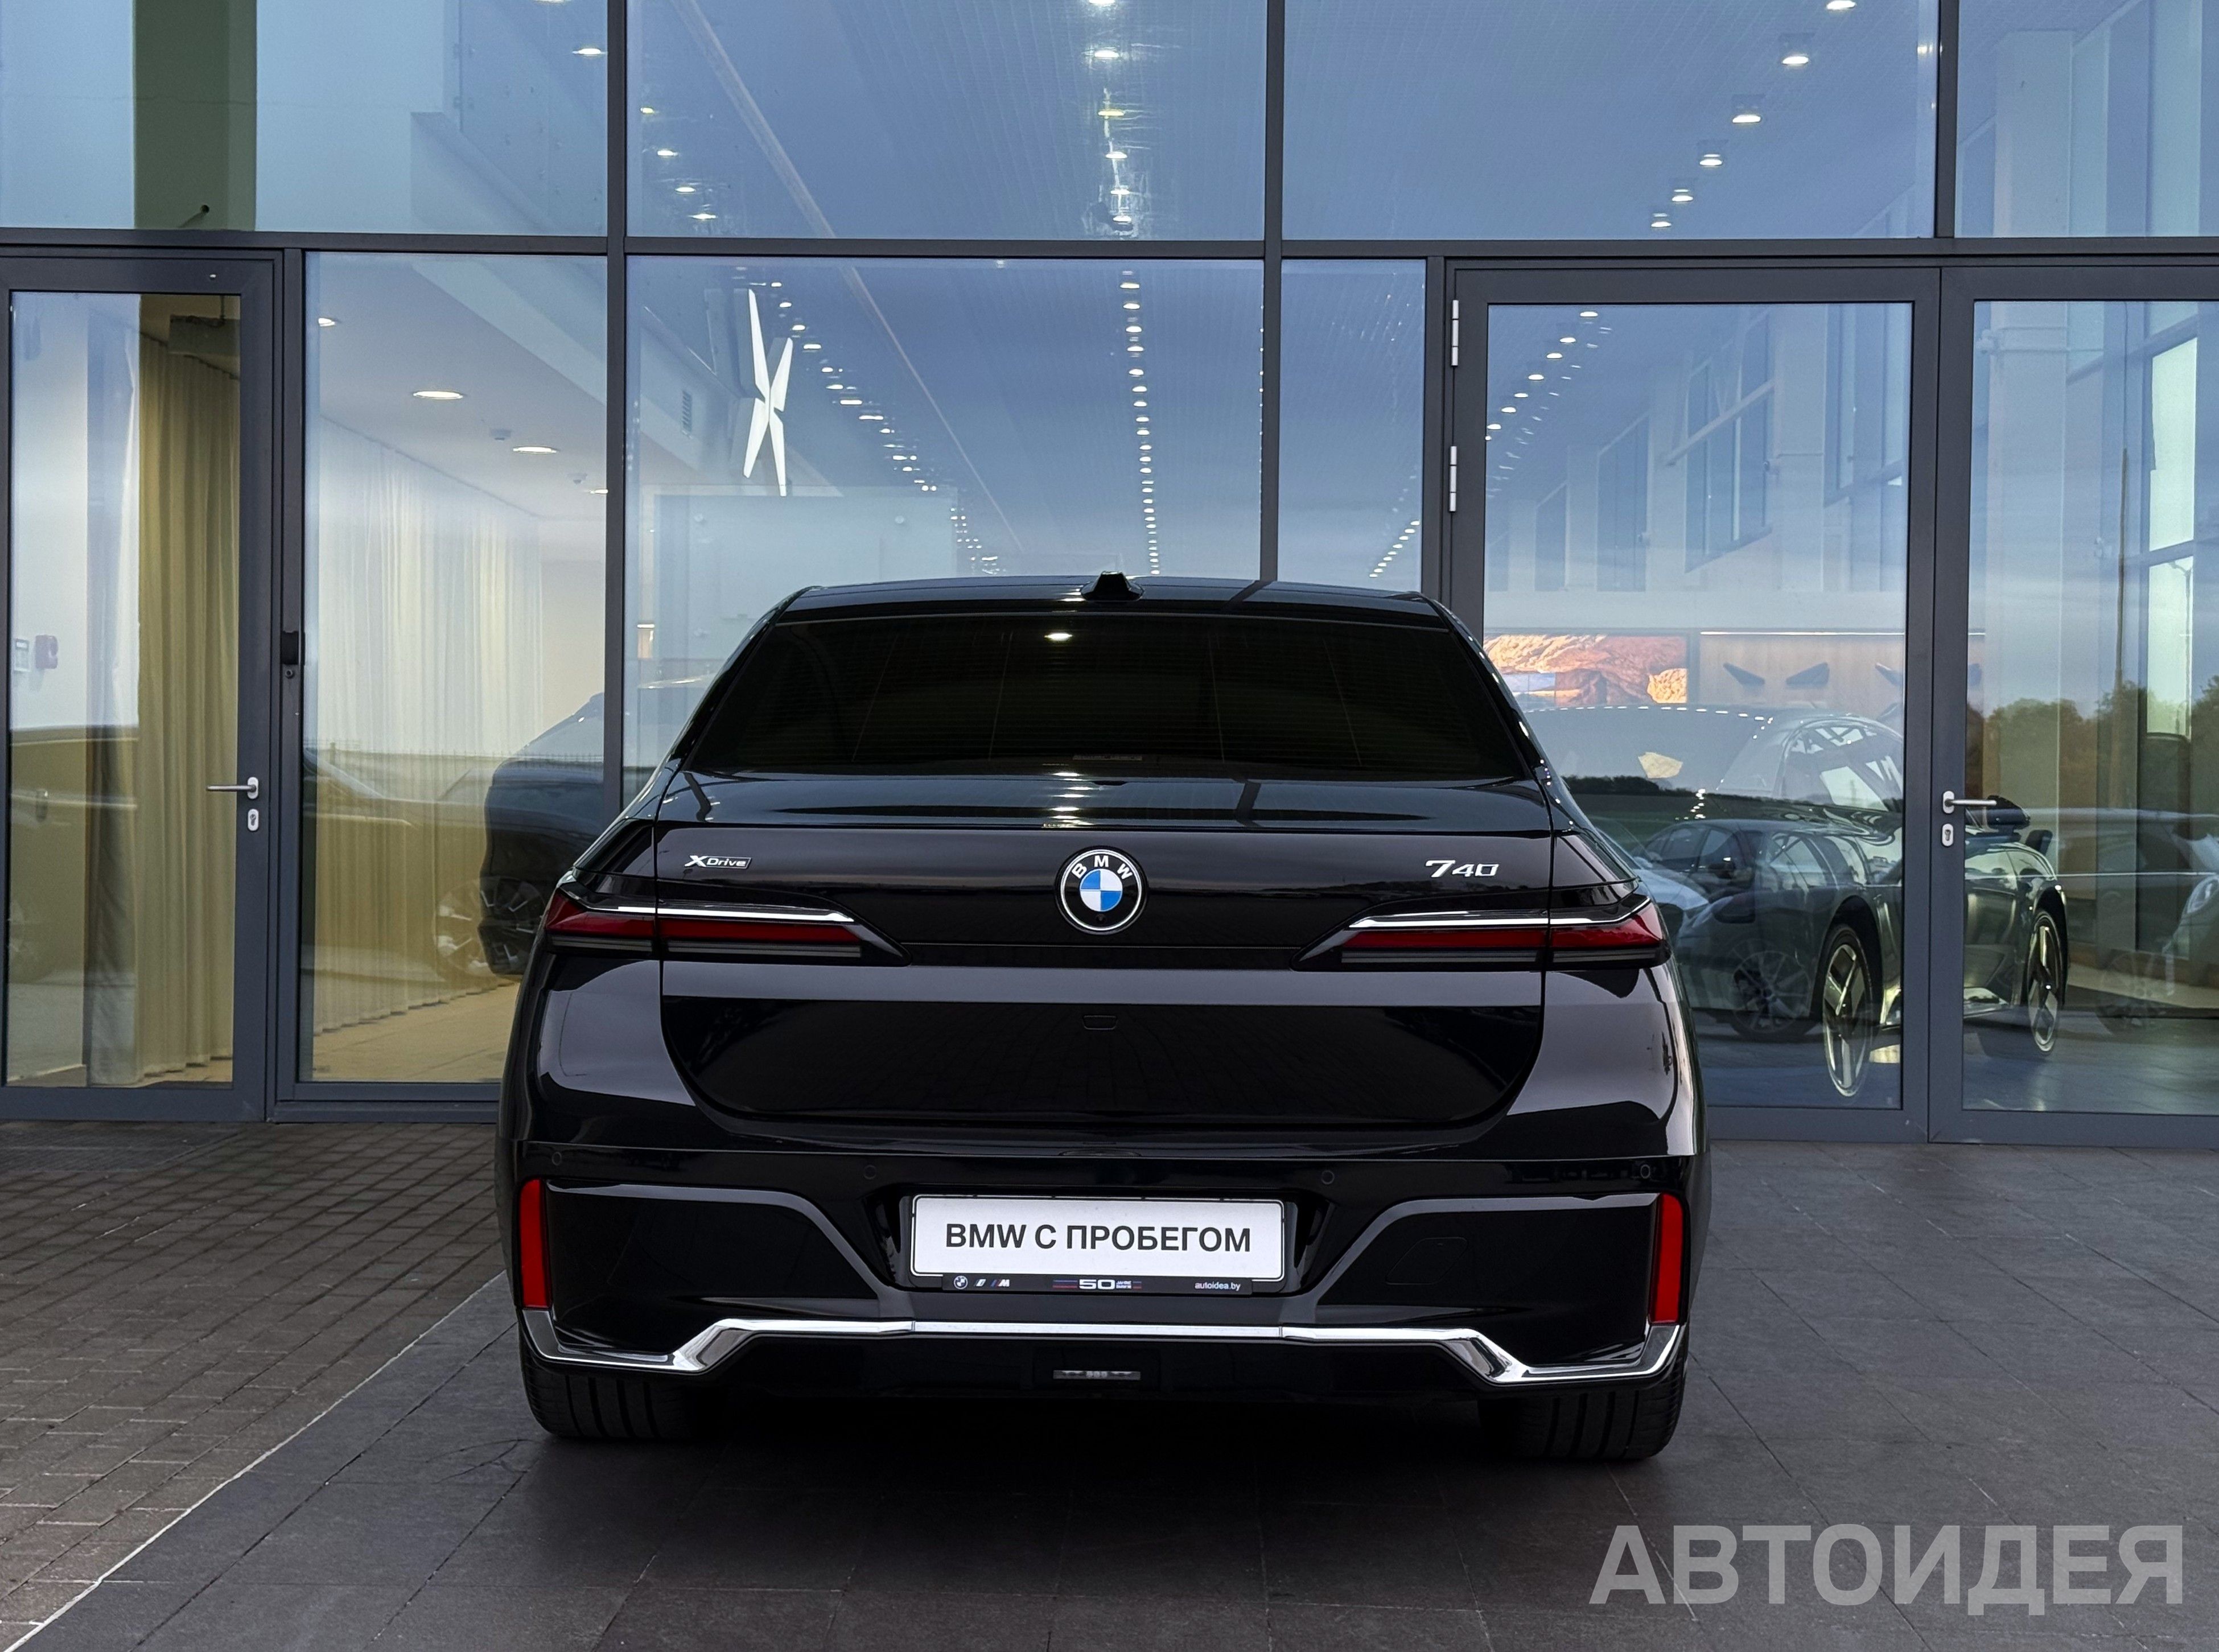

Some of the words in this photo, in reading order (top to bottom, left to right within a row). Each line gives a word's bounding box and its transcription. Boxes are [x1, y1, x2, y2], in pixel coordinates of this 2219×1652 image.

[1071, 855, 1133, 880] BMW
[1425, 860, 1500, 878] 740
[946, 1223, 1027, 1248] BMW
[1067, 1225, 1250, 1252] ПРОБЕГОМ
[1079, 1279, 1115, 1290] 50
[1195, 1281, 1241, 1291] autoidea.by
